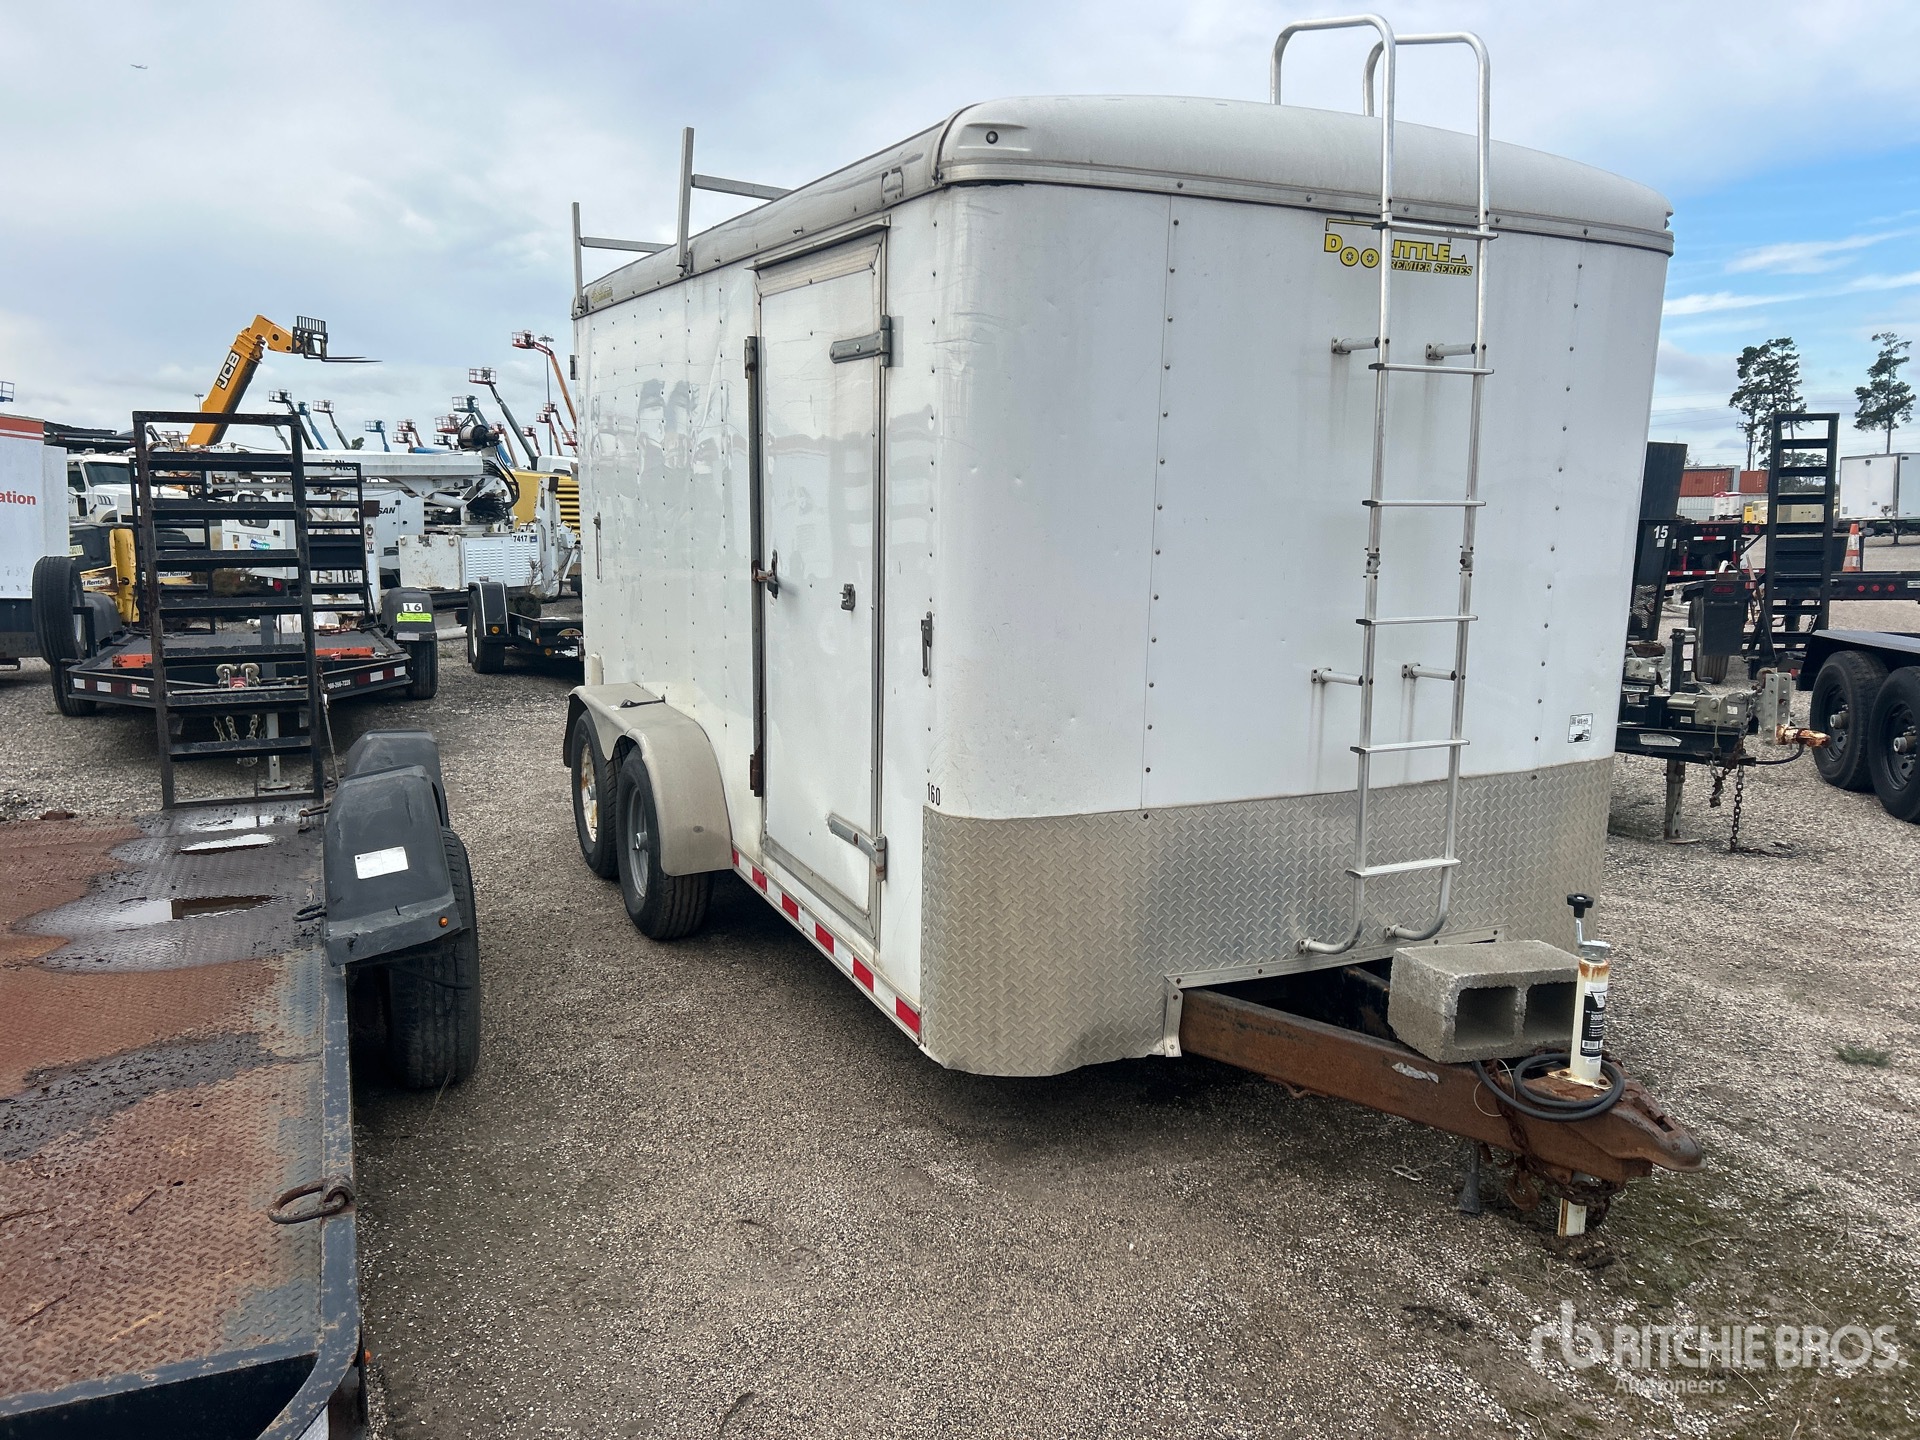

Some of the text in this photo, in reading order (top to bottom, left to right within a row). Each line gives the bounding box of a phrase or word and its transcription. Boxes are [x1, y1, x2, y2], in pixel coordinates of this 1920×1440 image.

[1324, 233, 1451, 268] DOOITTLE
[1391, 259, 1473, 276] REMIER SERIES
[220, 352, 240, 389] JCB
[0, 491, 36, 505] ation
[1654, 525, 1669, 539] 15
[406, 603, 421, 612] 16
[927, 782, 940, 806] 160
